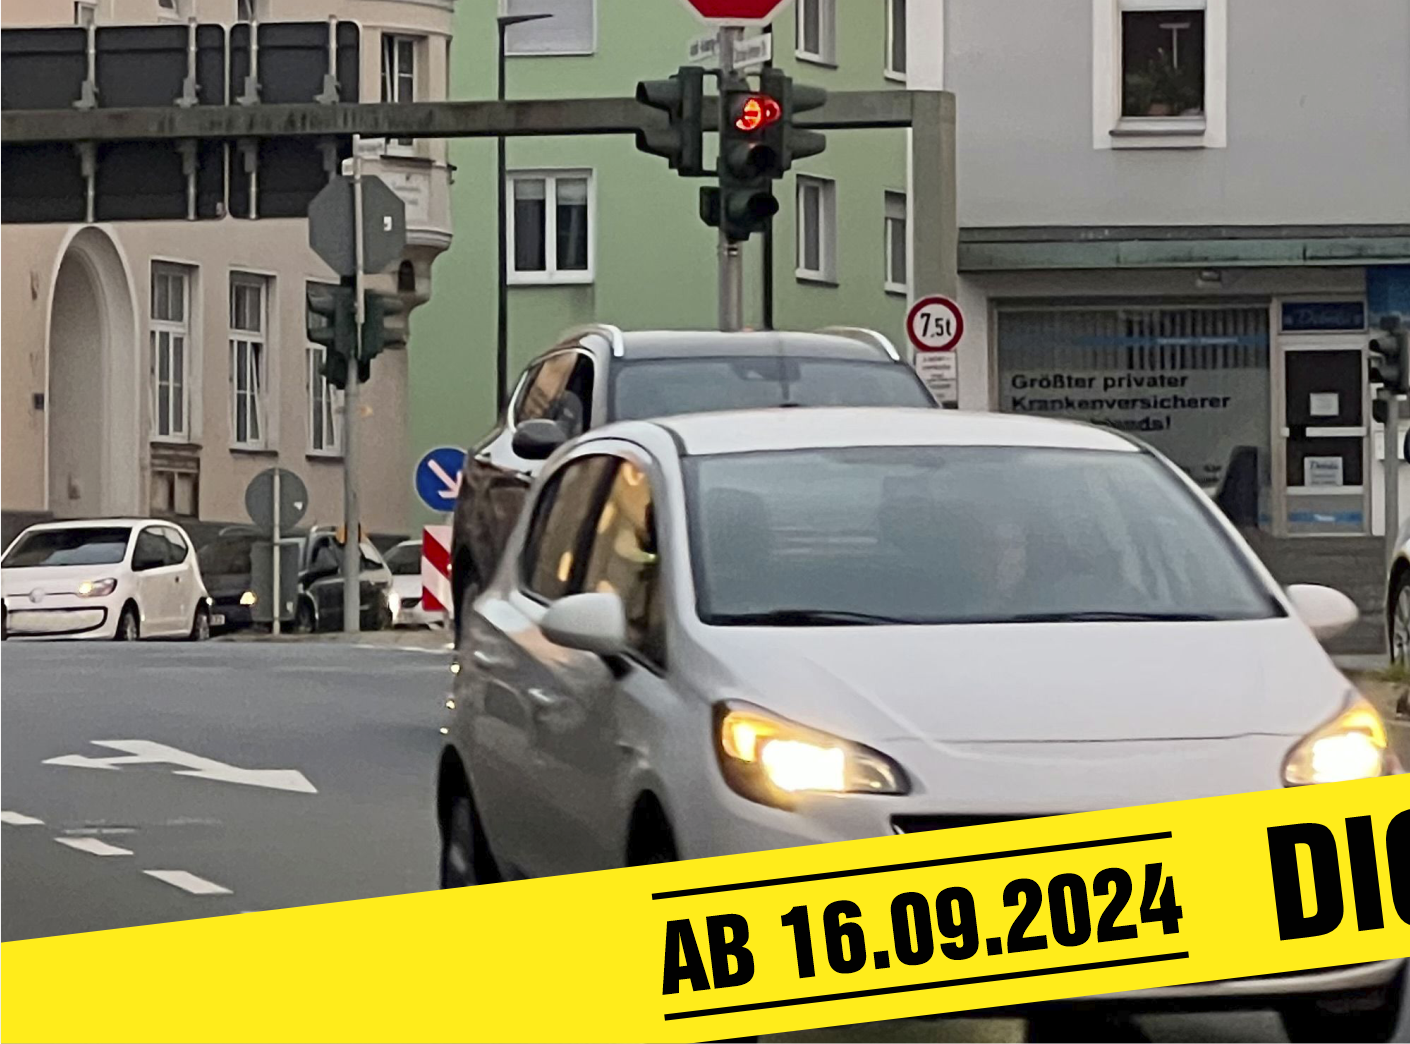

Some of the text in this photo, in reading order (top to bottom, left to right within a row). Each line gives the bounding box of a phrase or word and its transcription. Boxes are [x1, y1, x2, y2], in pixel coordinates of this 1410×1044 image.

[1011, 373, 1189, 392] Größter privater
[1011, 395, 1232, 412] Krankenversicherer
